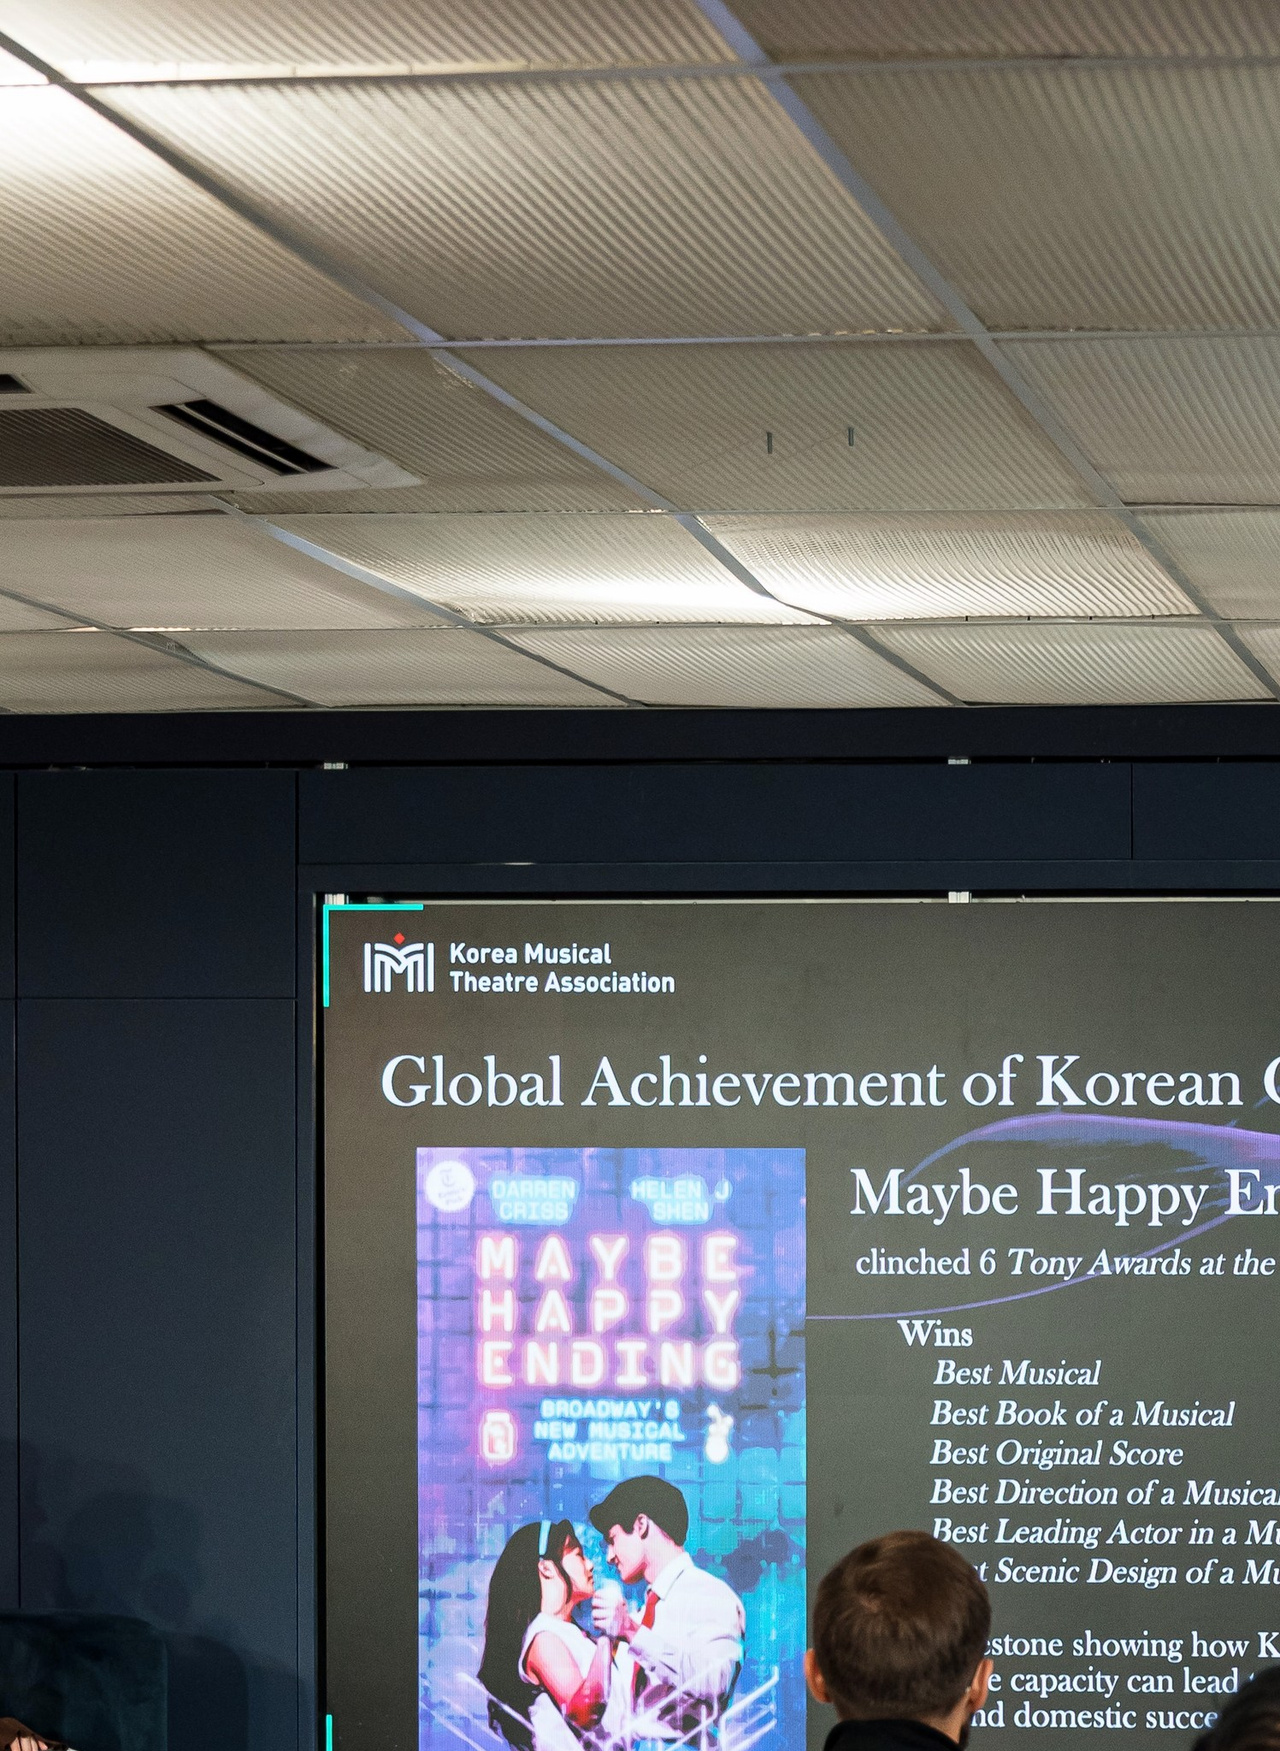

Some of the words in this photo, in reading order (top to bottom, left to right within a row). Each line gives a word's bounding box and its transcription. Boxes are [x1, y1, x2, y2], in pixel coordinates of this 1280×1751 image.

[450, 942, 518, 964] Korea
[524, 942, 612, 965] Musical
[449, 970, 539, 993] Theatre
[543, 971, 675, 993] Association
[381, 1054, 565, 1108] Global
[580, 1054, 948, 1107] Achievement
[962, 1053, 1025, 1107] of
[1035, 1055, 1244, 1106] Korean
[492, 1179, 576, 1200] DARREN
[630, 1179, 702, 1200] HELEN
[714, 1179, 730, 1200] J
[849, 1166, 1019, 1226] Maybe
[1036, 1168, 1210, 1230] Happy
[499, 1201, 569, 1221] CRISS
[652, 1201, 710, 1221] SHEN
[480, 1236, 739, 1282] MAYBE
[855, 1247, 972, 1276] clinched
[979, 1247, 997, 1276] 6
[1007, 1247, 1085, 1283] Tony
[1088, 1245, 1192, 1280] Awards
[1199, 1253, 1227, 1276] at
[1232, 1248, 1276, 1276] the
[480, 1288, 740, 1333] HAPPY
[896, 1318, 974, 1347] Wins
[481, 1340, 739, 1386] ENDING
[932, 1359, 994, 1385] Best
[997, 1359, 1102, 1386] Musical
[541, 1399, 680, 1420] BROADWAY'S
[929, 1399, 990, 1426] Best
[994, 1399, 1068, 1426] Book
[1075, 1399, 1109, 1426] of
[1108, 1408, 1124, 1427] a
[1131, 1400, 1236, 1427] Musical
[534, 1421, 577, 1440] NEW
[588, 1421, 686, 1441] MUSICAL
[548, 1442, 673, 1462] ADVENTURE
[929, 1439, 990, 1465] Best
[995, 1438, 1103, 1471] Original
[1108, 1439, 1184, 1466] Score
[929, 1478, 990, 1505] Best
[993, 1478, 1118, 1505] Direction
[1126, 1478, 1160, 1505] of
[1160, 1487, 1176, 1506] a
[933, 1517, 990, 1544] Best
[994, 1518, 1103, 1550] Leading
[1106, 1518, 1184, 1545] Actor
[1187, 1518, 1214, 1545] in
[1221, 1527, 1237, 1545] a
[994, 1556, 1081, 1584] Scenic
[1086, 1558, 1177, 1589] Design
[1185, 1558, 1224, 1585] of
[1219, 1567, 1235, 1585] a
[1072, 1629, 1184, 1664] showing
[1191, 1630, 1250, 1658] how
[1010, 1665, 1120, 1699] capacity
[1126, 1674, 1175, 1693] can
[1183, 1666, 1239, 1694] lead
[971, 1702, 1006, 1728] nd
[1013, 1702, 1137, 1729] domestic
